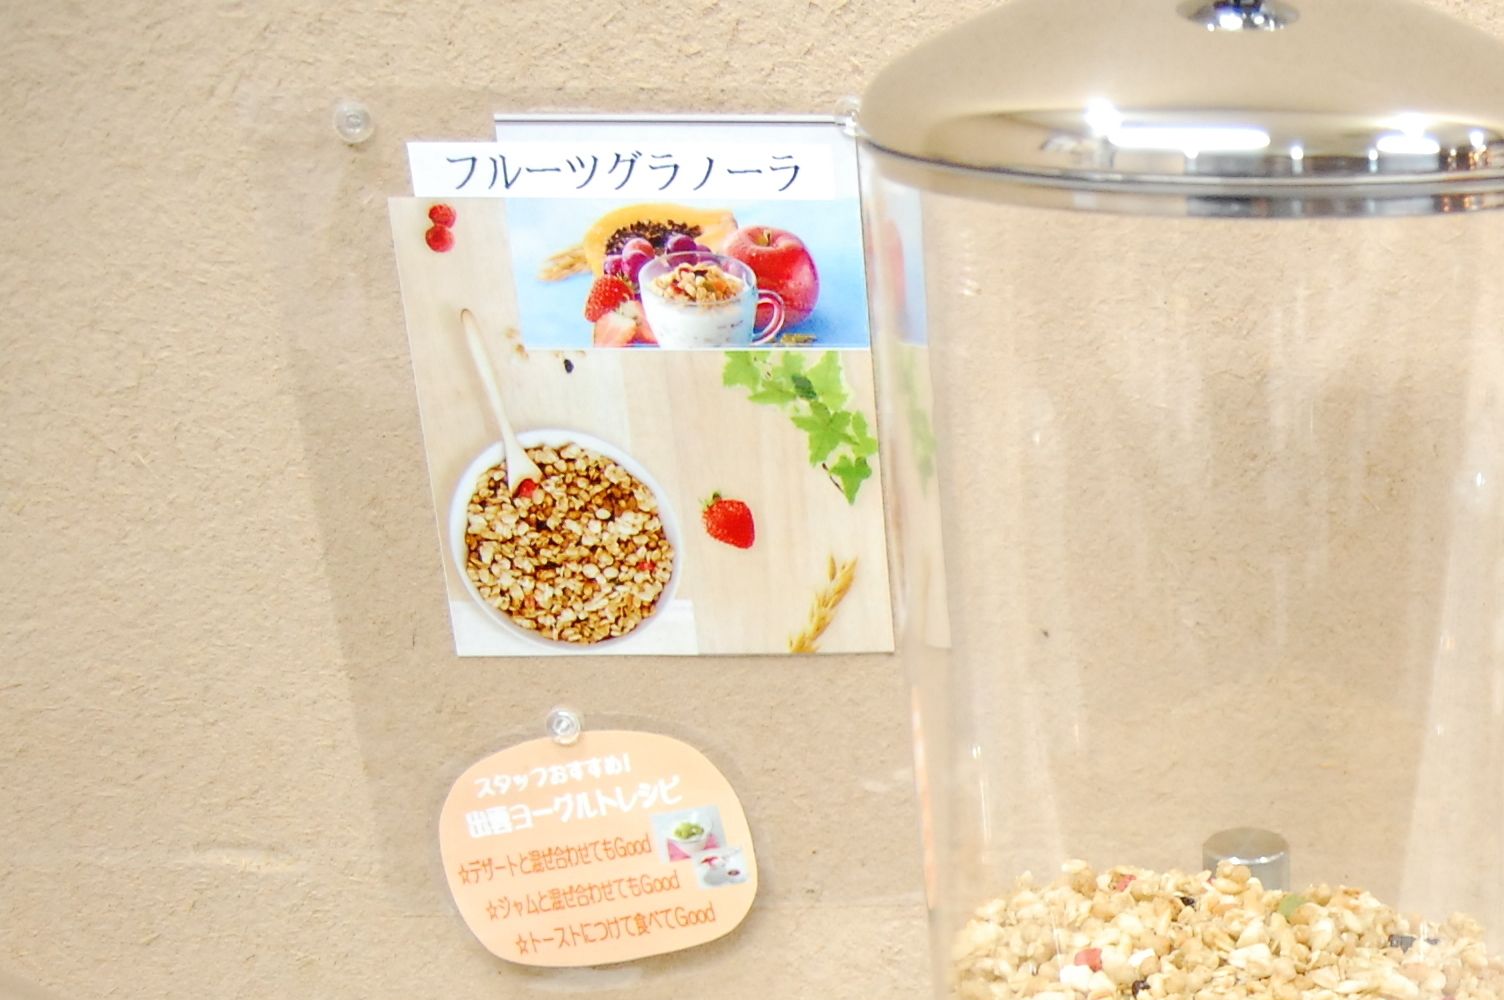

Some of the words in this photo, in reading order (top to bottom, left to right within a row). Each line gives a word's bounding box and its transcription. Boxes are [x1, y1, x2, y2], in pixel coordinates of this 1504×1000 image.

[446, 150, 800, 192] フルーツグラノーラ
